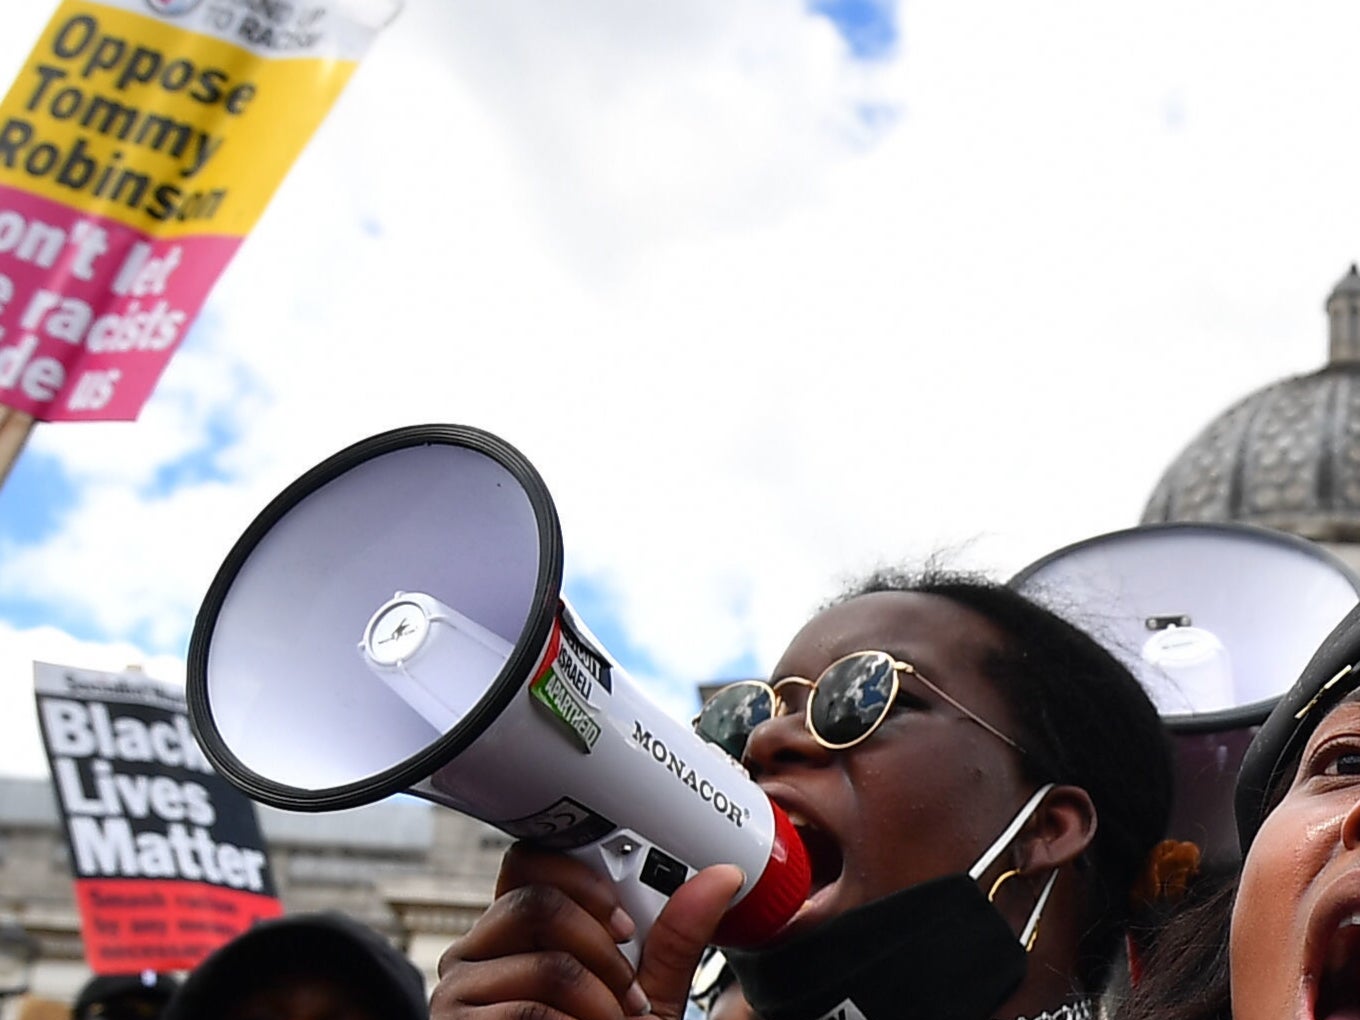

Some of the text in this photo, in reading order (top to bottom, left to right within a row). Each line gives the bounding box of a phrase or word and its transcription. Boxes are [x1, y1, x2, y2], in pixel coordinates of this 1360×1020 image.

[52, 14, 257, 116] Oppose
[26, 64, 225, 177] Tommy
[0, 119, 228, 223] Robinson
[112, 241, 183, 296] let
[20, 289, 187, 353] racists
[559, 643, 593, 699] ISRAELI
[545, 674, 598, 746] APARTHEID
[55, 757, 216, 827] Lives
[68, 816, 266, 891] Matter
